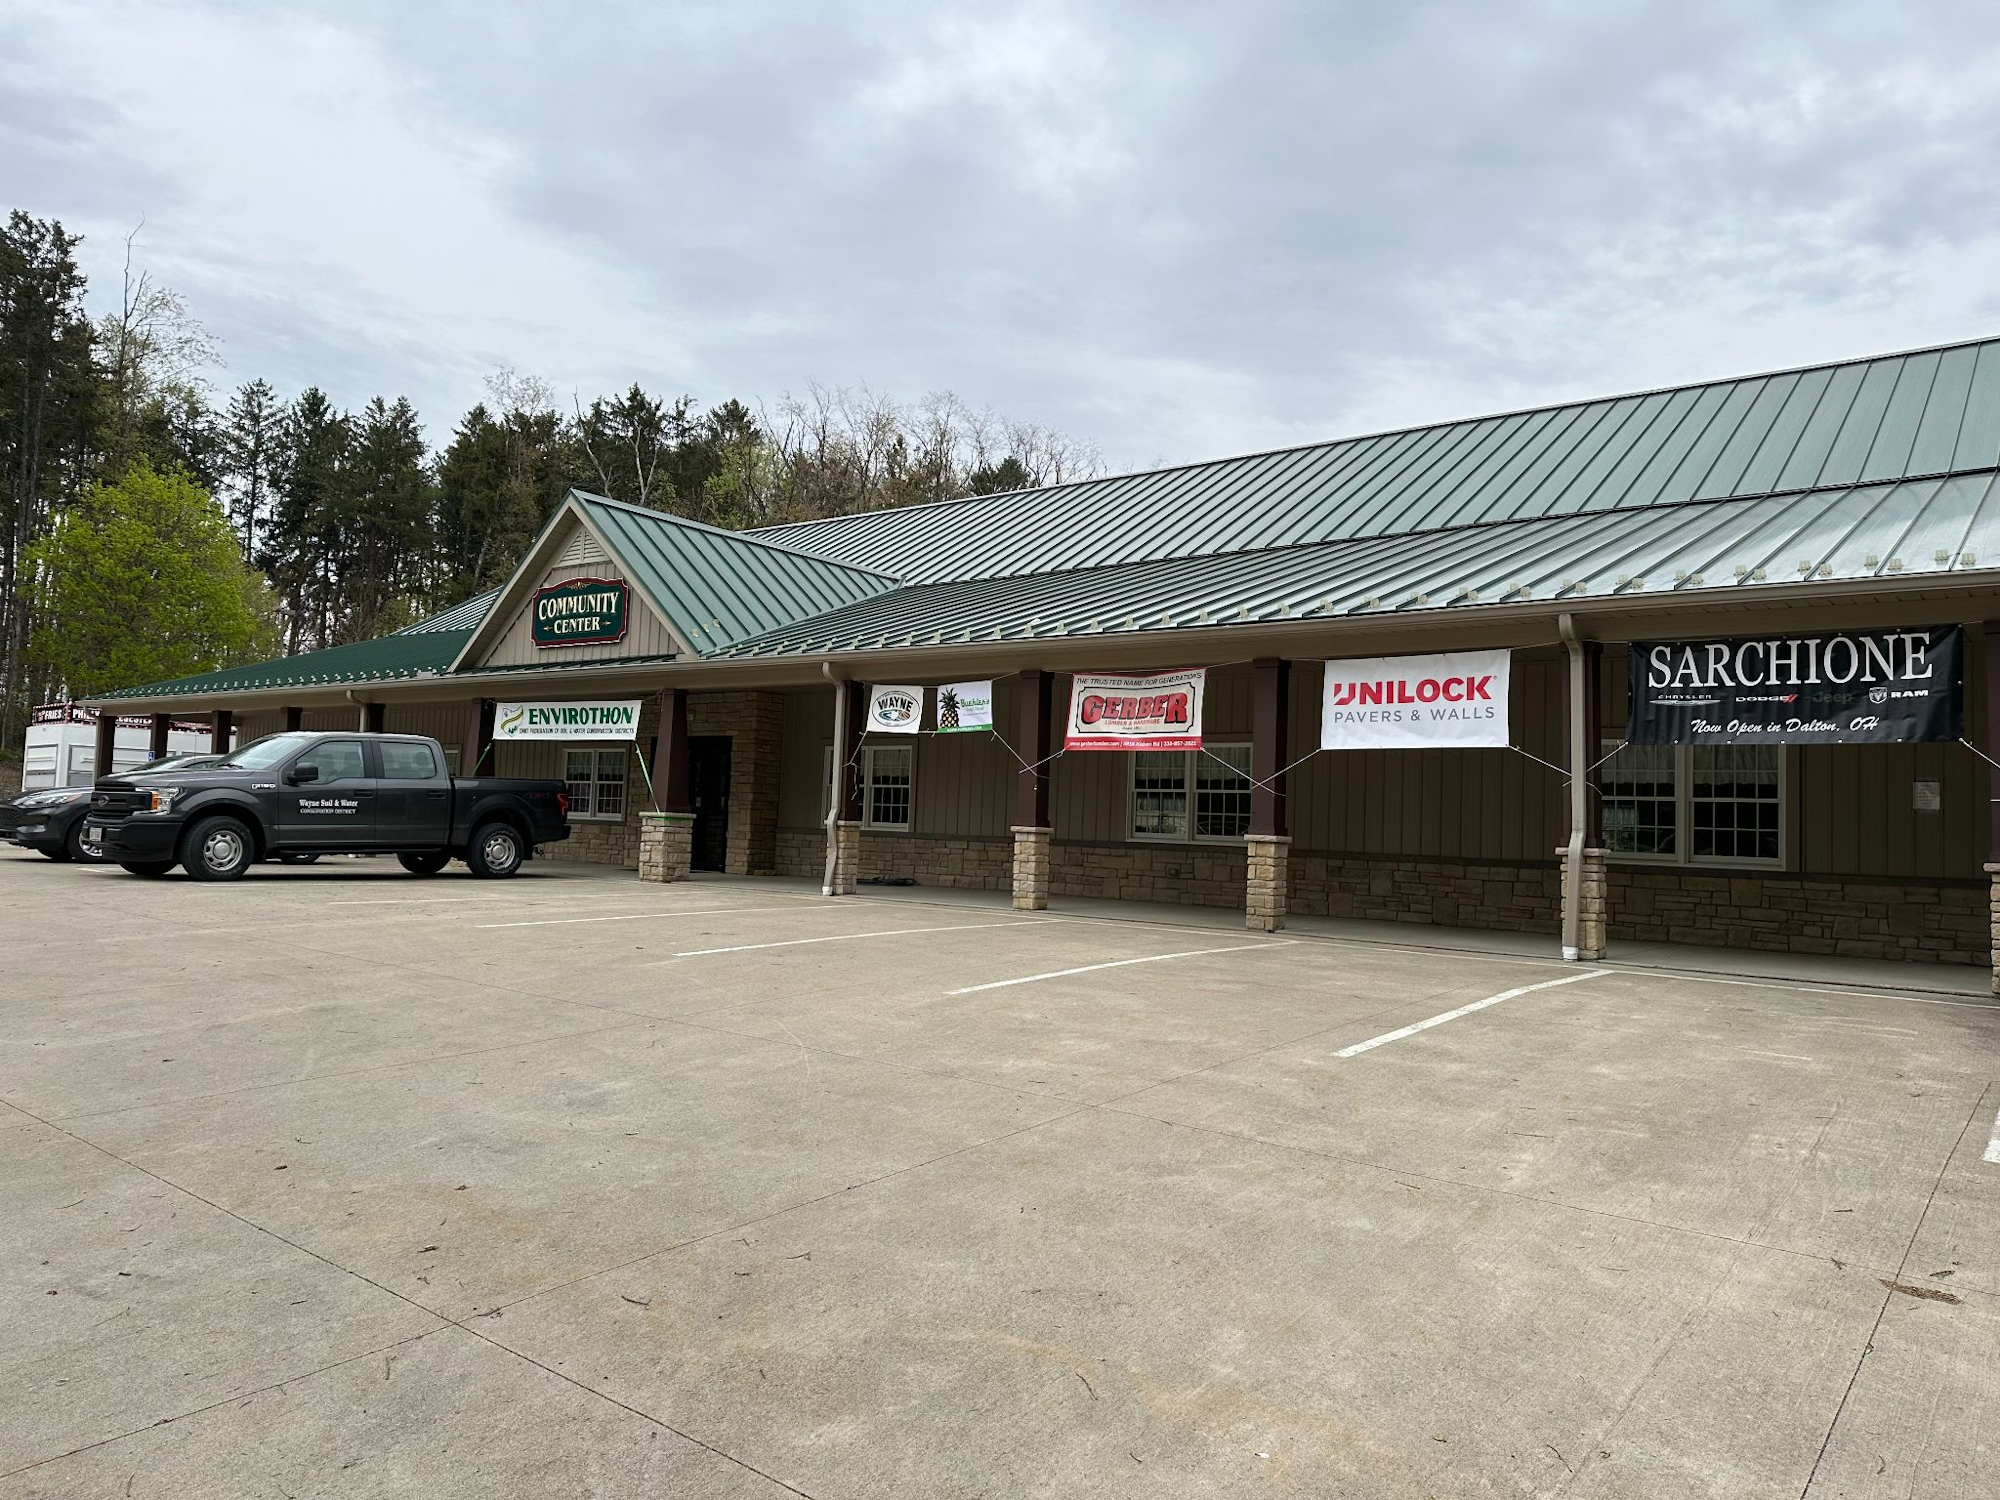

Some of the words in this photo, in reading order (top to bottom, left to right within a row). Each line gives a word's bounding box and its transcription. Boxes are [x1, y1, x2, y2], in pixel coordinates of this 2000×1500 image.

[538, 592, 619, 620] COMMUNITY
[554, 617, 601, 634] CENTER
[1648, 632, 1933, 689] SARCHIONE
[1090, 678, 1122, 686] TRUSTED
[1158, 673, 1202, 684] GENERATIONS
[1333, 675, 1493, 706] UNILOCK
[1812, 692, 1852, 704] Jeep
[1891, 690, 1929, 698] RAM
[878, 696, 914, 712] WAYNE
[1081, 692, 1188, 725] GERBER
[44, 709, 62, 720] FRIES
[528, 706, 634, 725] ENVIROTHON
[1334, 710, 1402, 723] PAVERS
[1410, 709, 1421, 722] &
[1430, 706, 1495, 721] WALLS
[1690, 719, 1722, 733] Now
[1726, 719, 1762, 736] Open
[1767, 722, 1782, 733] in
[1849, 716, 1880, 731] OH
[299, 799, 320, 809] Wayne
[320, 799, 333, 807] Soil
[334, 799, 340, 807] &
[340, 799, 358, 807] Water
